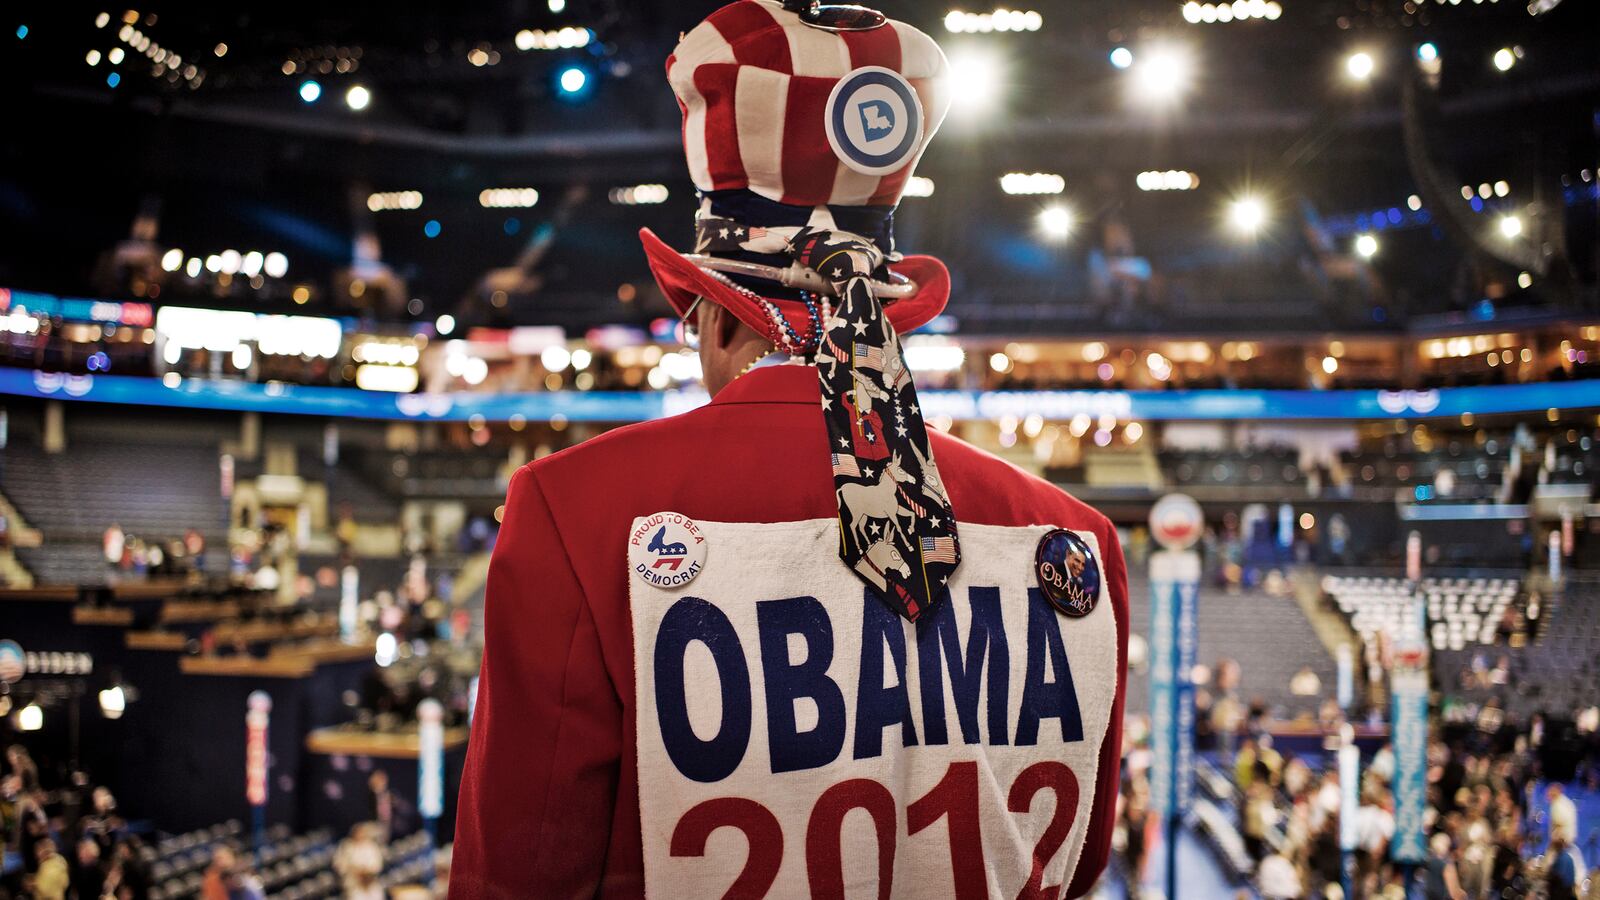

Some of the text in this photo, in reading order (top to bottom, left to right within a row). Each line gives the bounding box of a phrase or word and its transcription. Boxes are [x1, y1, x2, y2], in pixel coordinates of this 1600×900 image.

[631, 513, 705, 546] PROUD TO BE A
[636, 560, 702, 586] DEMOCRAT
[1040, 561, 1093, 610] OBAMA
[1069, 596, 1087, 614] 2012
[654, 586, 1084, 783] OBAMA
[669, 760, 1080, 900] 2012
